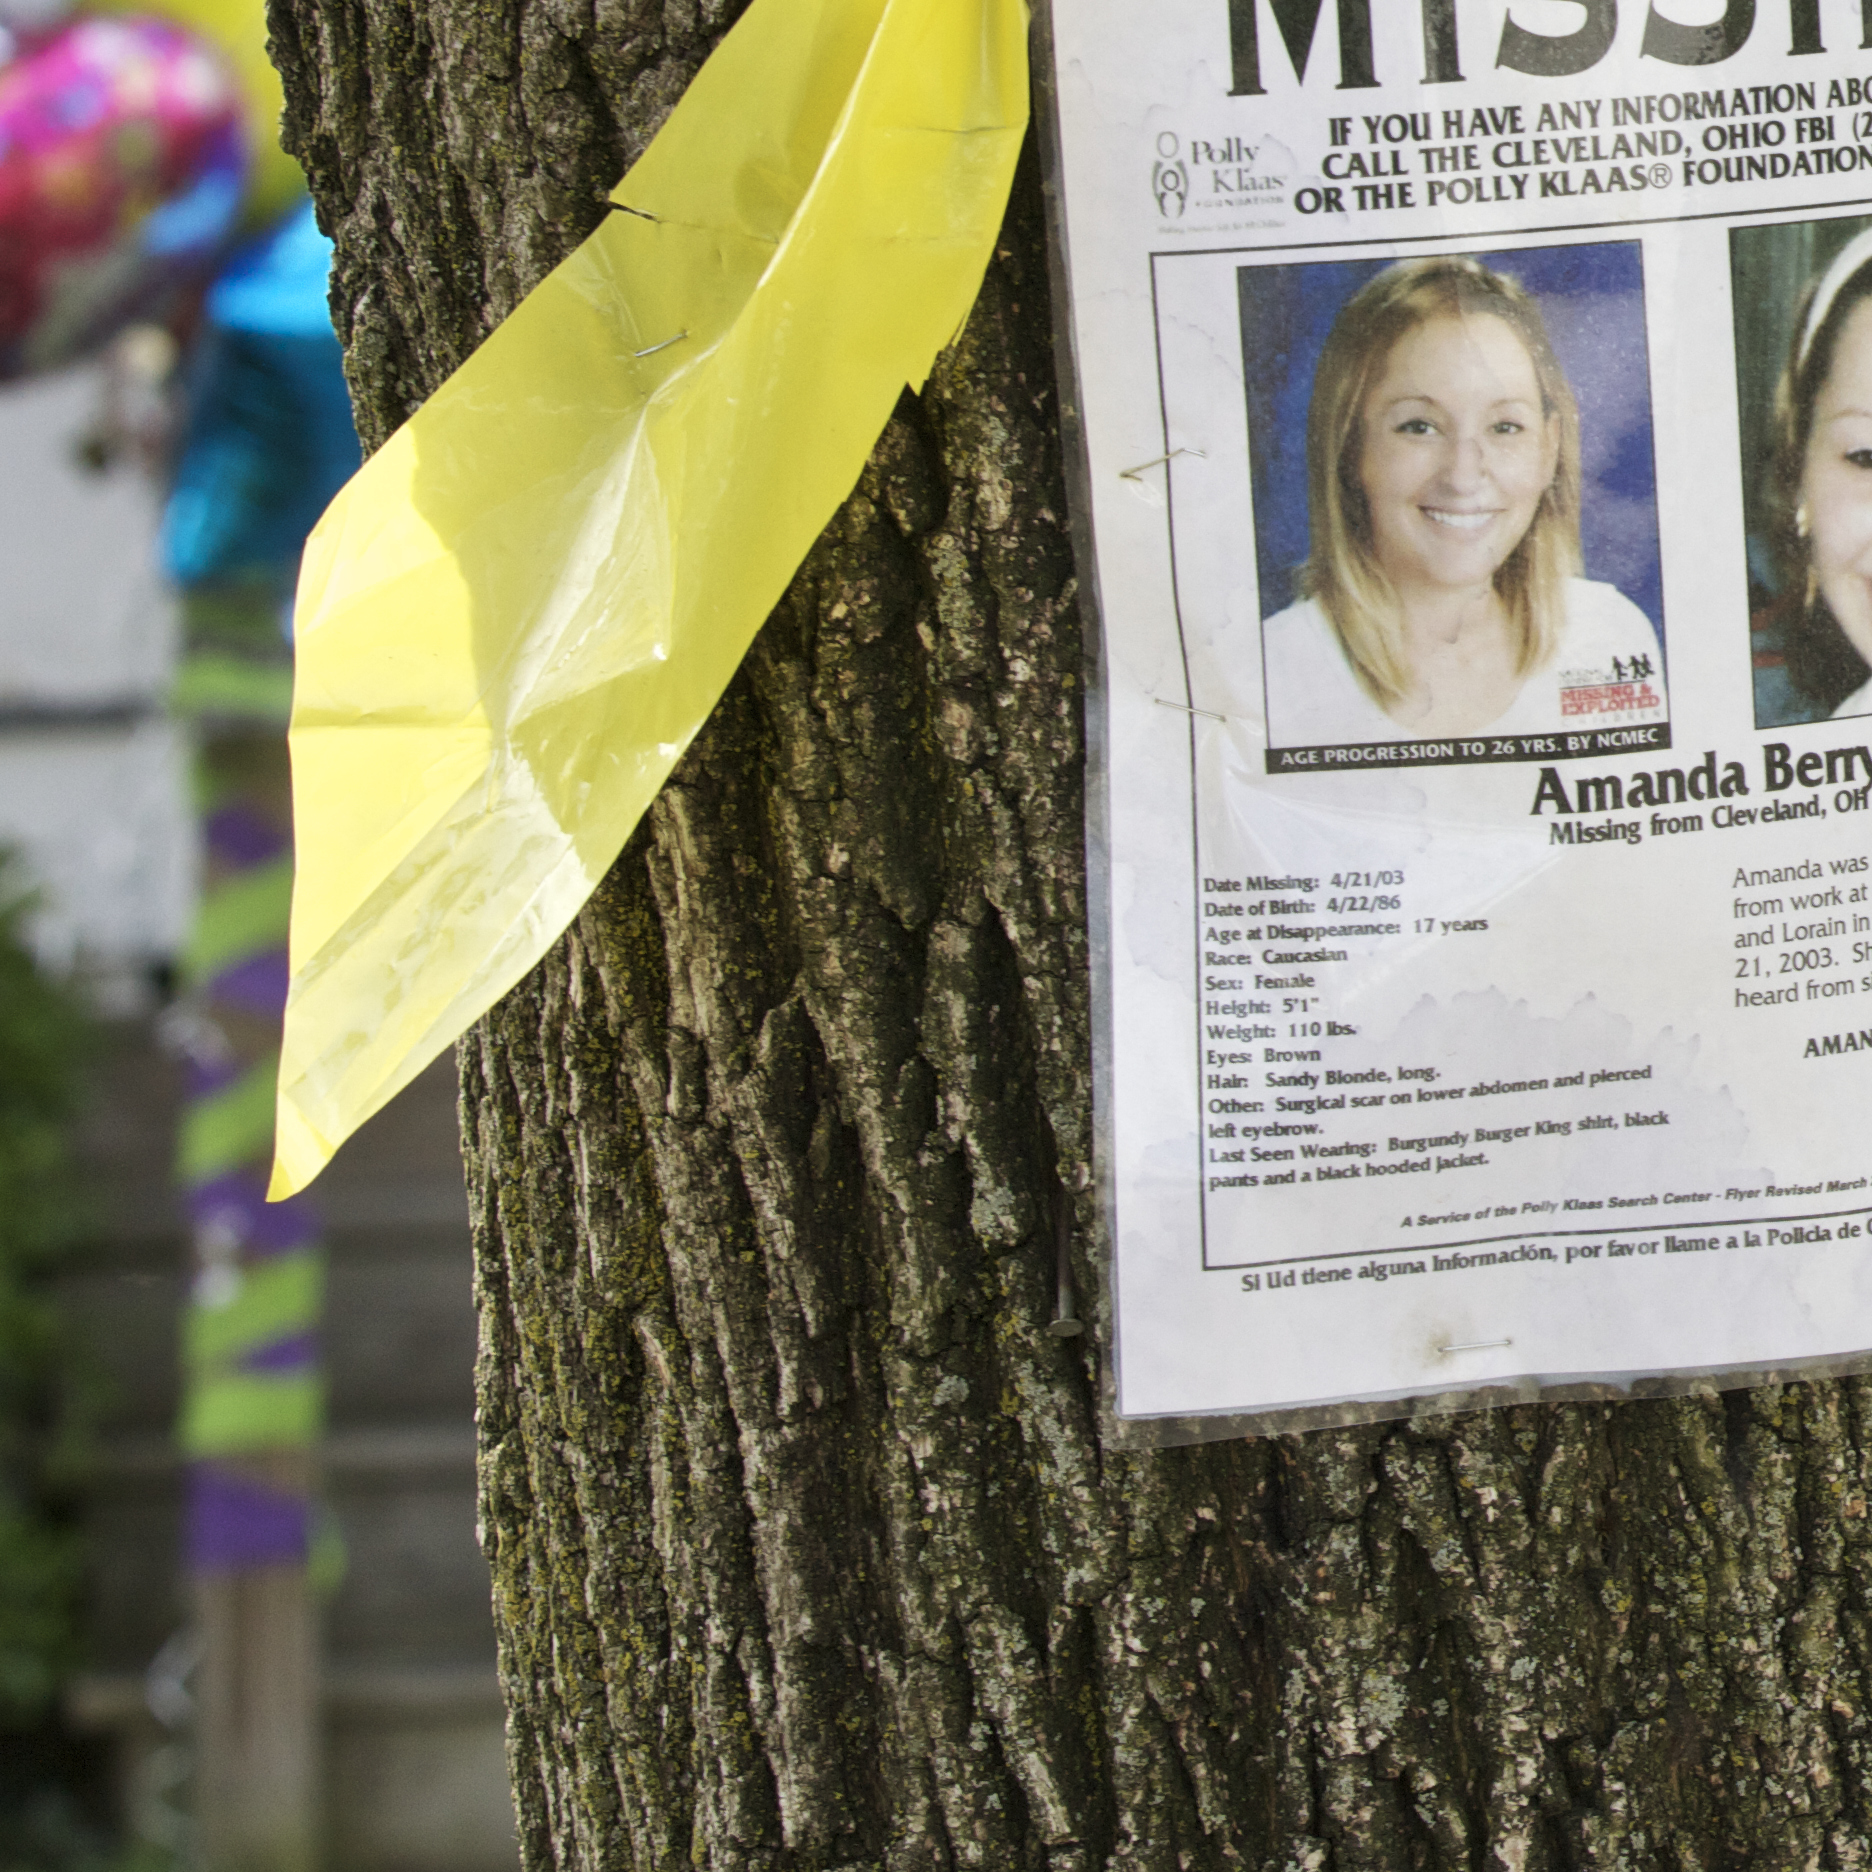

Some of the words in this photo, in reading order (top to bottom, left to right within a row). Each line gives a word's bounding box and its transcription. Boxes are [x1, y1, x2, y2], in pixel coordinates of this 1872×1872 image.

[1328, 116, 1353, 147] IF
[1361, 111, 1433, 145] YOU
[1441, 104, 1526, 140] HAVE
[1535, 98, 1602, 133] ANY
[1610, 81, 1816, 127] INFORMATION
[1191, 137, 1259, 164] Polly
[1321, 149, 1410, 181] CALL
[1417, 143, 1482, 175] THE
[1491, 129, 1693, 169] CLEVELAND,
[1701, 119, 1787, 153] OHIO
[1794, 114, 1836, 145] FBI
[1212, 167, 1285, 193] Klaas
[1293, 186, 1347, 215] OR
[1350, 181, 1417, 212] THE
[1426, 173, 1530, 207] POLLY
[1281, 751, 1319, 766] AGE
[1324, 744, 1453, 763] PROGRESSION
[1460, 742, 1485, 757] TO
[1492, 740, 1515, 755] 26
[1521, 737, 1562, 754] YRS.
[1567, 735, 1591, 751] BY
[1597, 729, 1658, 749] NCMEC
[1528, 749, 1751, 816] Amanda
[1549, 817, 1643, 846] Missing
[1649, 812, 1704, 837] from
[1710, 793, 1827, 829] Cleveland,
[1834, 789, 1868, 813] OH
[1203, 877, 1243, 893] Date
[1245, 874, 1320, 894] Missing:
[1330, 869, 1405, 890] 4/21/03
[1732, 858, 1824, 889] Amanda
[1828, 855, 1870, 876] was
[1203, 901, 1245, 918] Date
[1247, 899, 1267, 917] of
[1268, 898, 1316, 916] Birth:
[1326, 894, 1402, 915] 4/22/86
[1733, 897, 1784, 919] from
[1789, 885, 1844, 911] work
[1848, 883, 1869, 904] at
[1205, 926, 1242, 946] Age
[1245, 926, 1263, 942] at
[1265, 923, 1401, 943] Disappearance:
[1414, 917, 1435, 934] 17
[1440, 918, 1490, 936] years
[1734, 924, 1775, 949] and
[1782, 916, 1847, 943] Lorain
[1852, 913, 1871, 933] in
[1204, 951, 1253, 967] Race:
[1261, 946, 1349, 965] Caucasian
[1734, 956, 1771, 979] 21,
[1779, 946, 1839, 974] 2003.
[1204, 975, 1243, 992] Sex:
[1254, 972, 1316, 990] Female
[1734, 981, 1799, 1008] heard
[1805, 978, 1855, 1001] from
[1205, 999, 1272, 1019] Height:
[1282, 997, 1320, 1014] 5'1"
[1206, 1023, 1277, 1043] Weight:
[1289, 1021, 1322, 1038] 110
[1325, 1020, 1358, 1037] lbs.
[1206, 1049, 1253, 1069] Eyes:
[1263, 1047, 1322, 1063] Brown
[1206, 1073, 1249, 1090] Hair:
[1265, 1070, 1320, 1091] Sandy
[1324, 1067, 1393, 1086] Blonde,
[1397, 1065, 1442, 1083] long.
[1207, 1097, 1265, 1115] Other:
[1274, 1093, 1346, 1116] Surgical
[1349, 1094, 1387, 1109] scar
[1388, 1092, 1413, 1105] on
[1416, 1087, 1467, 1103] lower
[1468, 1078, 1549, 1098] abdomen
[1552, 1070, 1585, 1089] and
[1588, 1064, 1653, 1089] pierced
[1208, 1122, 1238, 1139] left
[1240, 1121, 1325, 1142] eyebrow.
[1209, 1148, 1246, 1163] Last
[1249, 1146, 1295, 1163] Seen
[1299, 1141, 1378, 1159] Wearing:
[1387, 1130, 1470, 1153] Burgundy
[1473, 1125, 1532, 1144] Burger
[1534, 1119, 1573, 1137] King
[1577, 1114, 1619, 1131] shirt,
[1624, 1110, 1670, 1128] black
[1208, 1173, 1260, 1193] pants
[1262, 1168, 1297, 1186] and
[1299, 1171, 1313, 1183] a
[1315, 1163, 1362, 1182] black
[1364, 1156, 1432, 1177] hooded
[1416, 1211, 1472, 1227] Service
[1562, 1198, 1604, 1211] Klaas
[1606, 1193, 1659, 1209] Search
[1662, 1191, 1713, 1205] Center
[1724, 1187, 1762, 1202] Flyer
[1764, 1181, 1824, 1198] Revised
[1825, 1176, 1868, 1193] March
[1265, 1269, 1297, 1290] Ud
[1300, 1266, 1353, 1286] tiene
[1356, 1260, 1428, 1282] alguna
[1564, 1244, 1604, 1265] por
[1606, 1239, 1660, 1258] favor
[1663, 1235, 1721, 1254] llame
[1743, 1230, 1763, 1248] la
[1836, 1221, 1862, 1240] de
